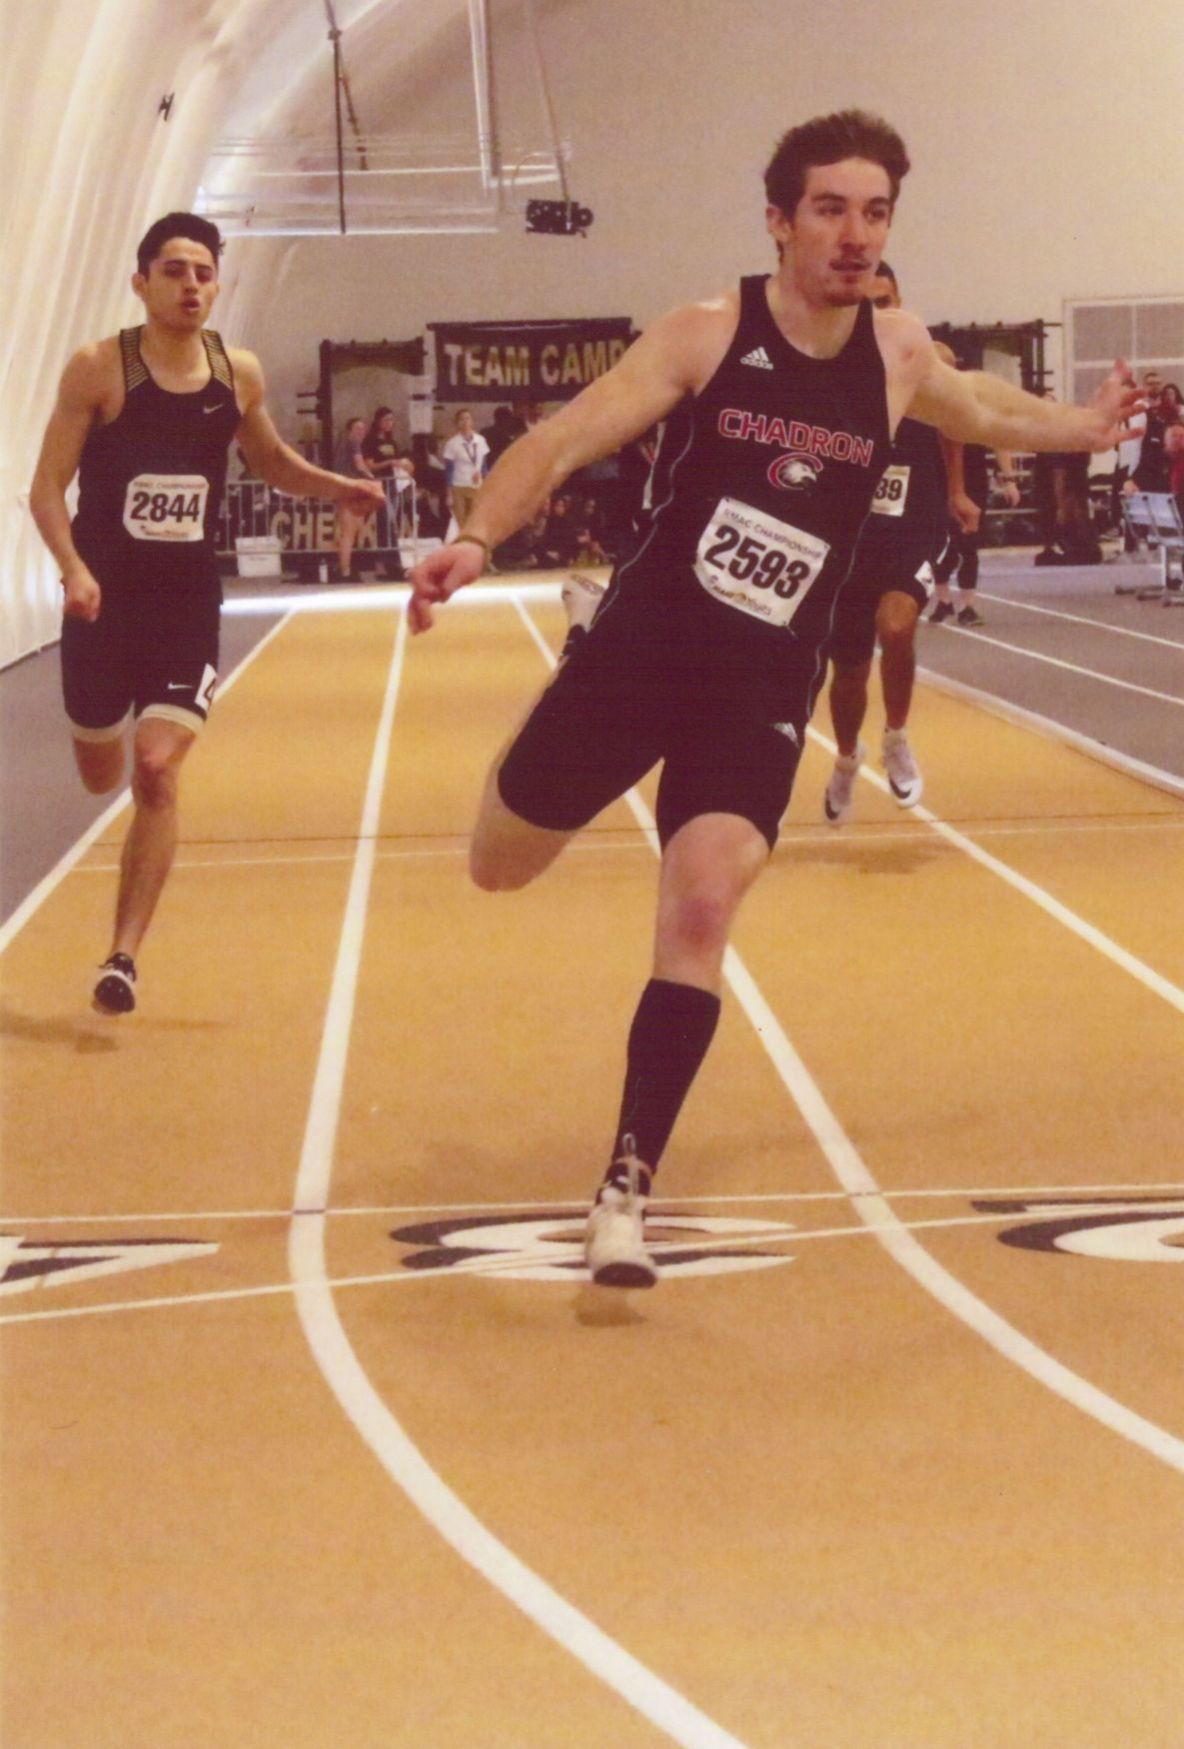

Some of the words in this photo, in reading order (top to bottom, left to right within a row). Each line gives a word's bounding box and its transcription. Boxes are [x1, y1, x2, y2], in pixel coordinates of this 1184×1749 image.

[444, 343, 530, 386] TEAM
[718, 408, 874, 468] CHADRON
[130, 491, 200, 523] 2844
[270, 511, 378, 549] CHEK
[703, 524, 811, 600] 2593
